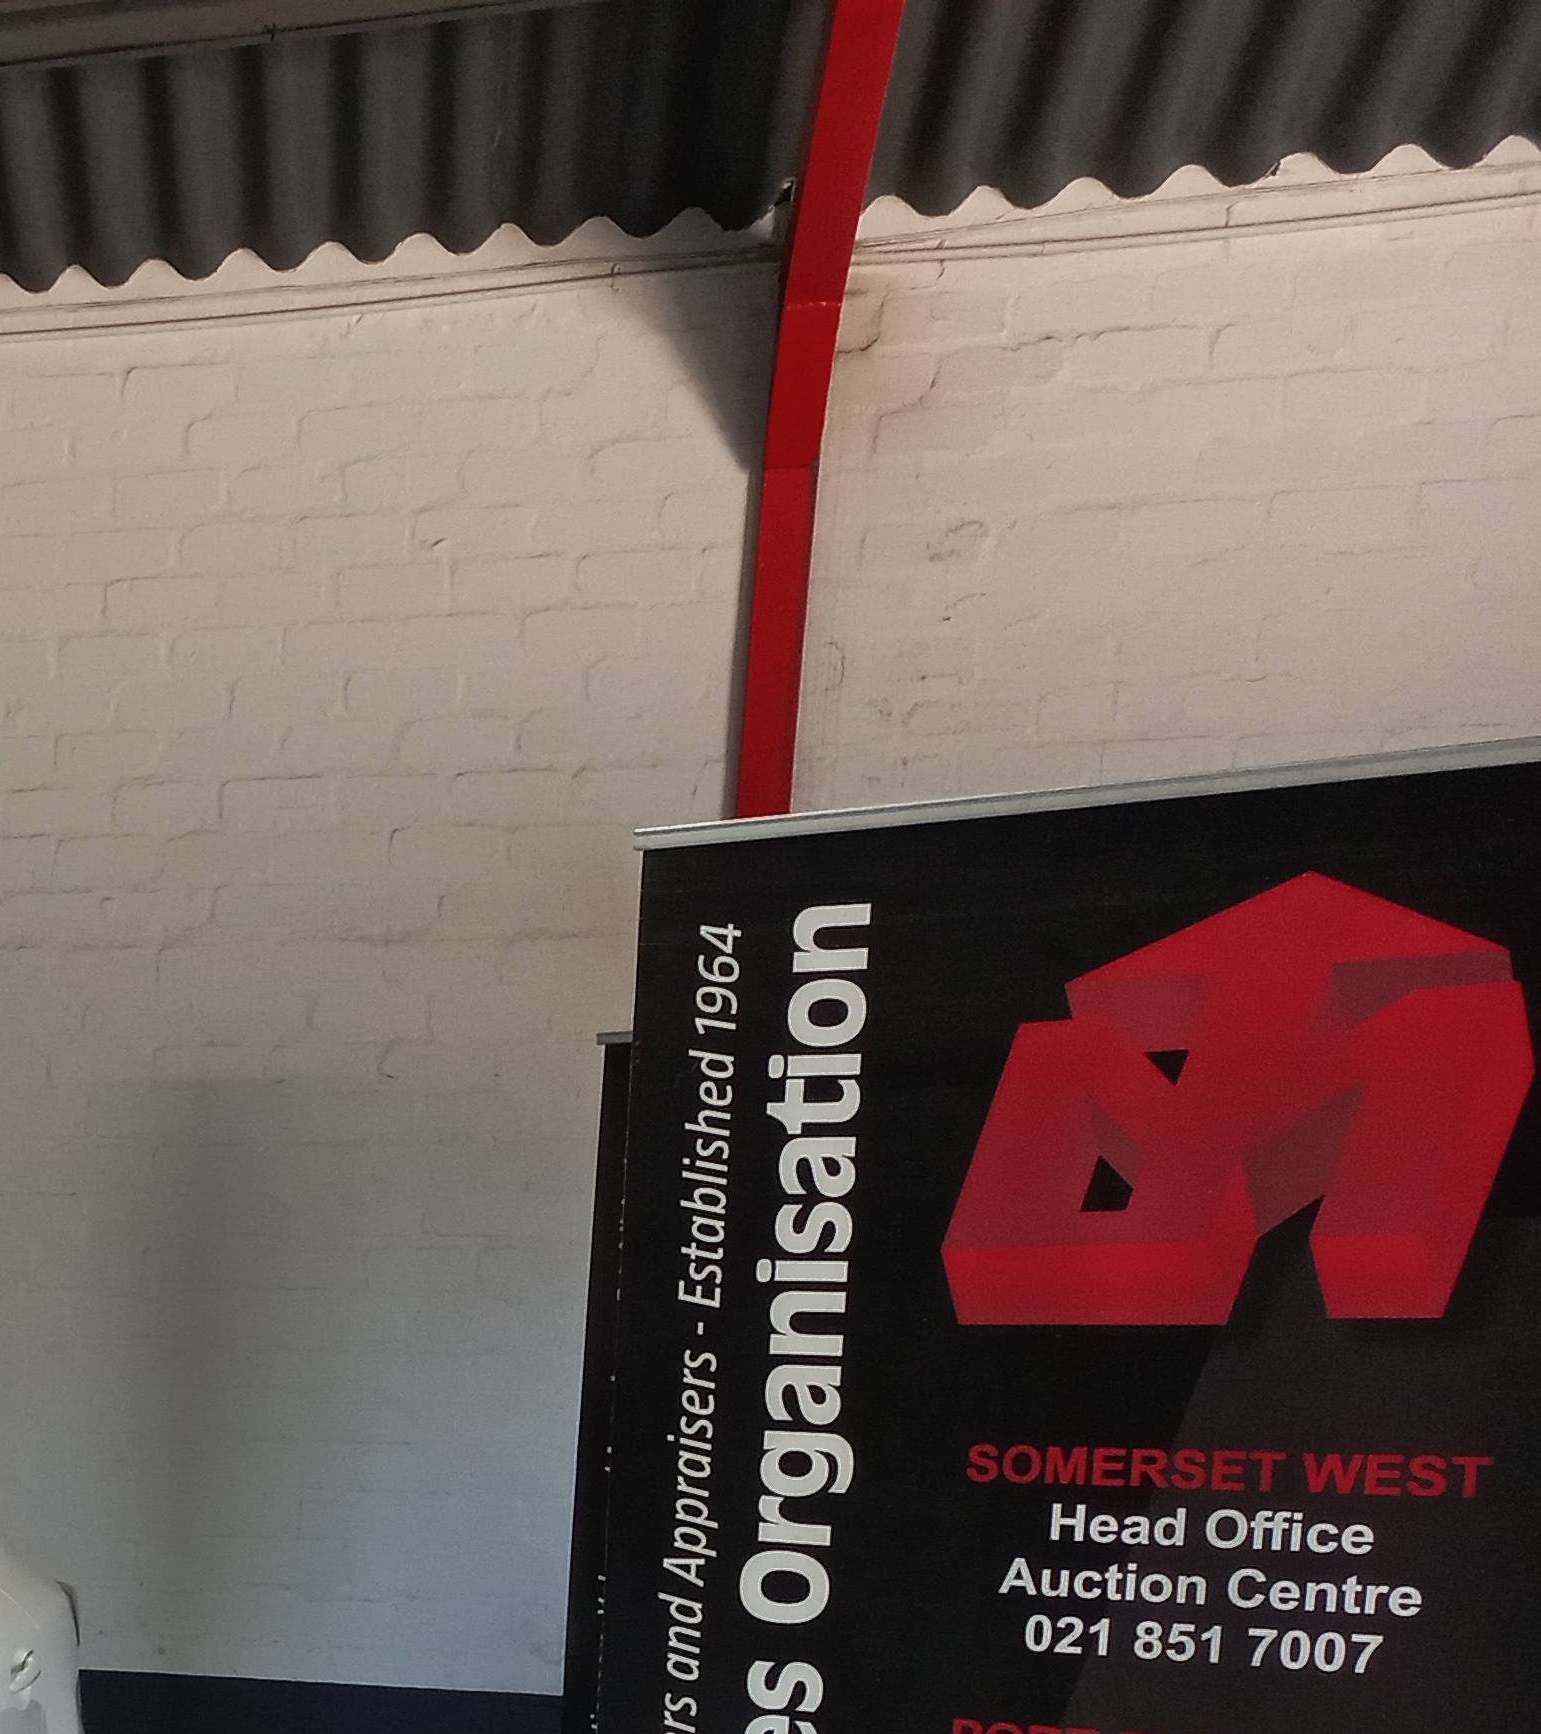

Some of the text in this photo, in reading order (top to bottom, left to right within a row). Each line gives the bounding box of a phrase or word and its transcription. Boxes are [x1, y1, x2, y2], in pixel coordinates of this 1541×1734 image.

[695, 924, 741, 1034] 1964
[678, 1049, 734, 1307] Established
[740, 903, 871, 1624] Organisation
[663, 1350, 718, 1587] Appraisers
[968, 1444, 1491, 1496] SOMERSET WEST
[1051, 1503, 1374, 1554] Head Office
[999, 1558, 1421, 1616] Auction Centre
[658, 1593, 702, 1680] and
[1026, 1615, 1383, 1673] 021 851 7007
